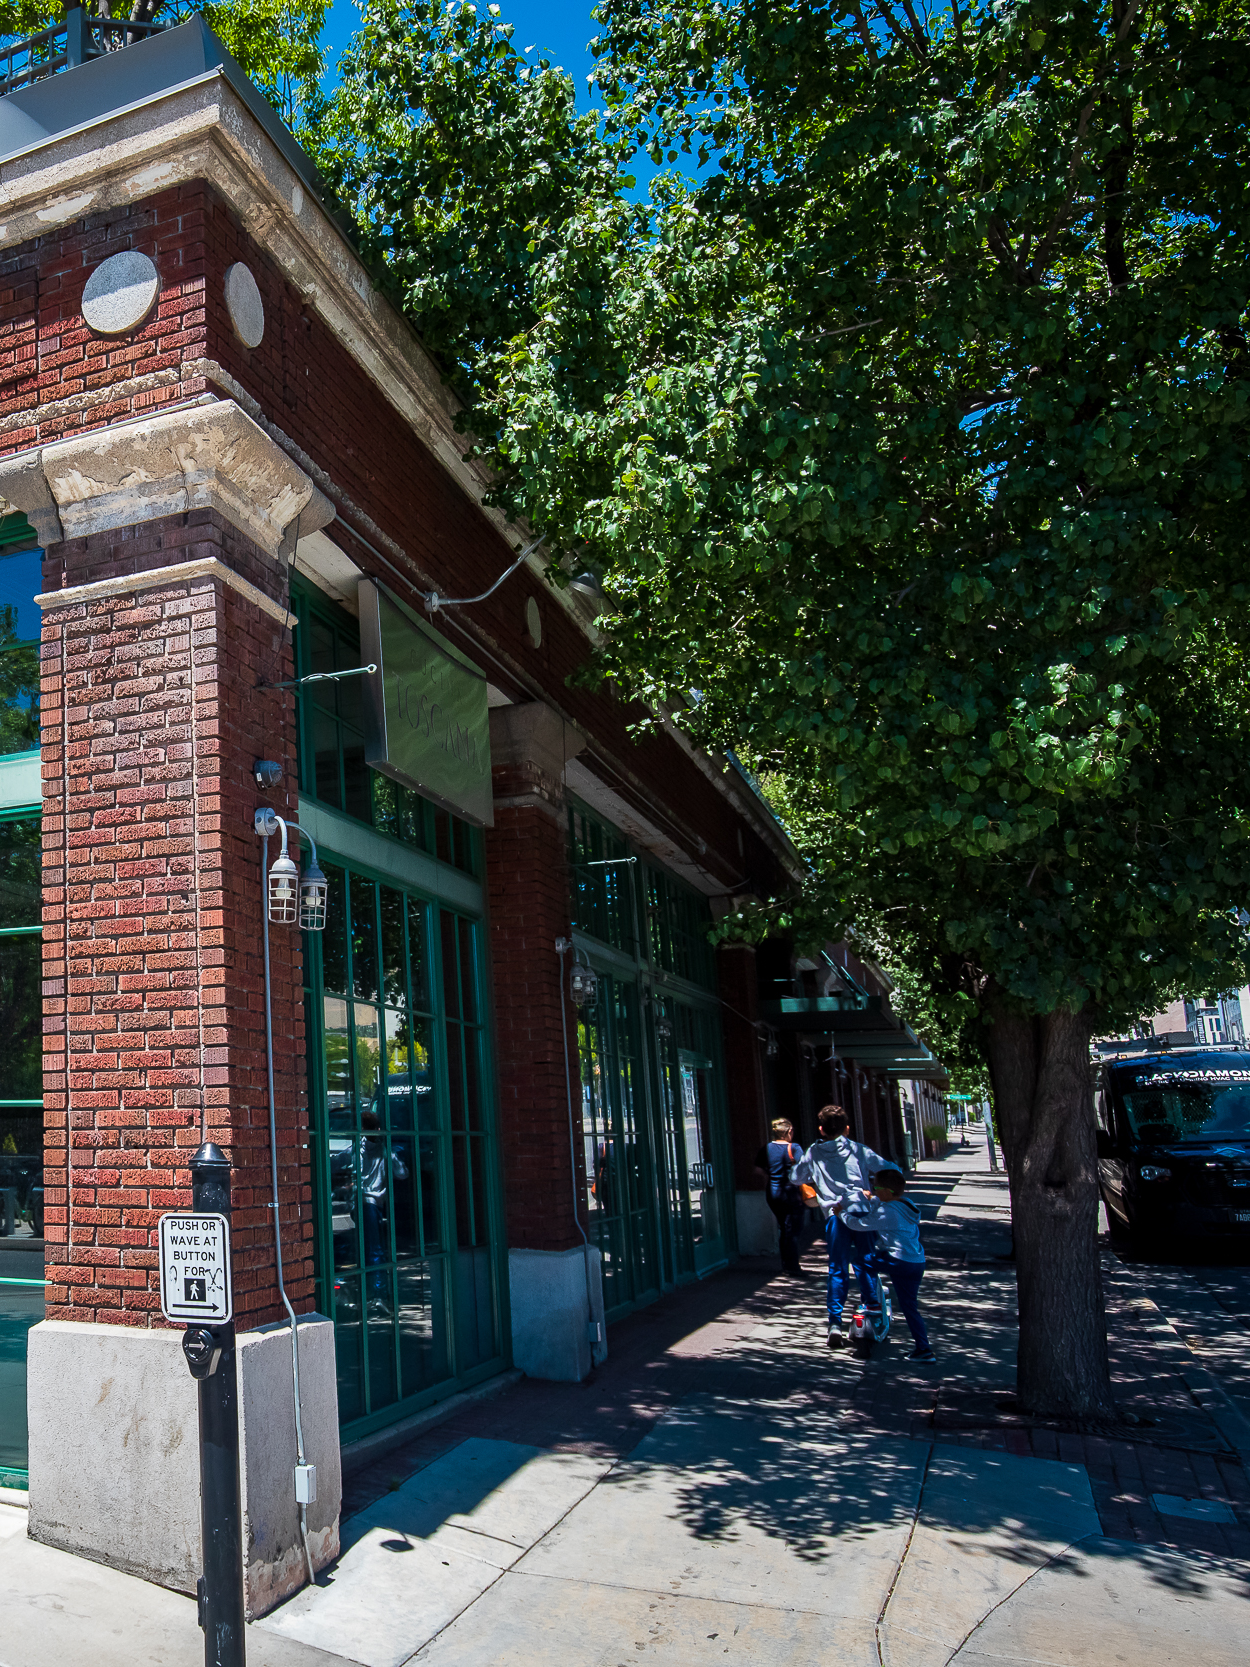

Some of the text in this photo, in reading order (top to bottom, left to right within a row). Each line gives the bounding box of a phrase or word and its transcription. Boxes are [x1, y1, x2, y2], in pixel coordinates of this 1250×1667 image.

[171, 1221, 216, 1231] PUSH OR
[170, 1236, 218, 1246] WAVE AT
[174, 1251, 215, 1261] BUTTON
[184, 1266, 205, 1276] FOR
